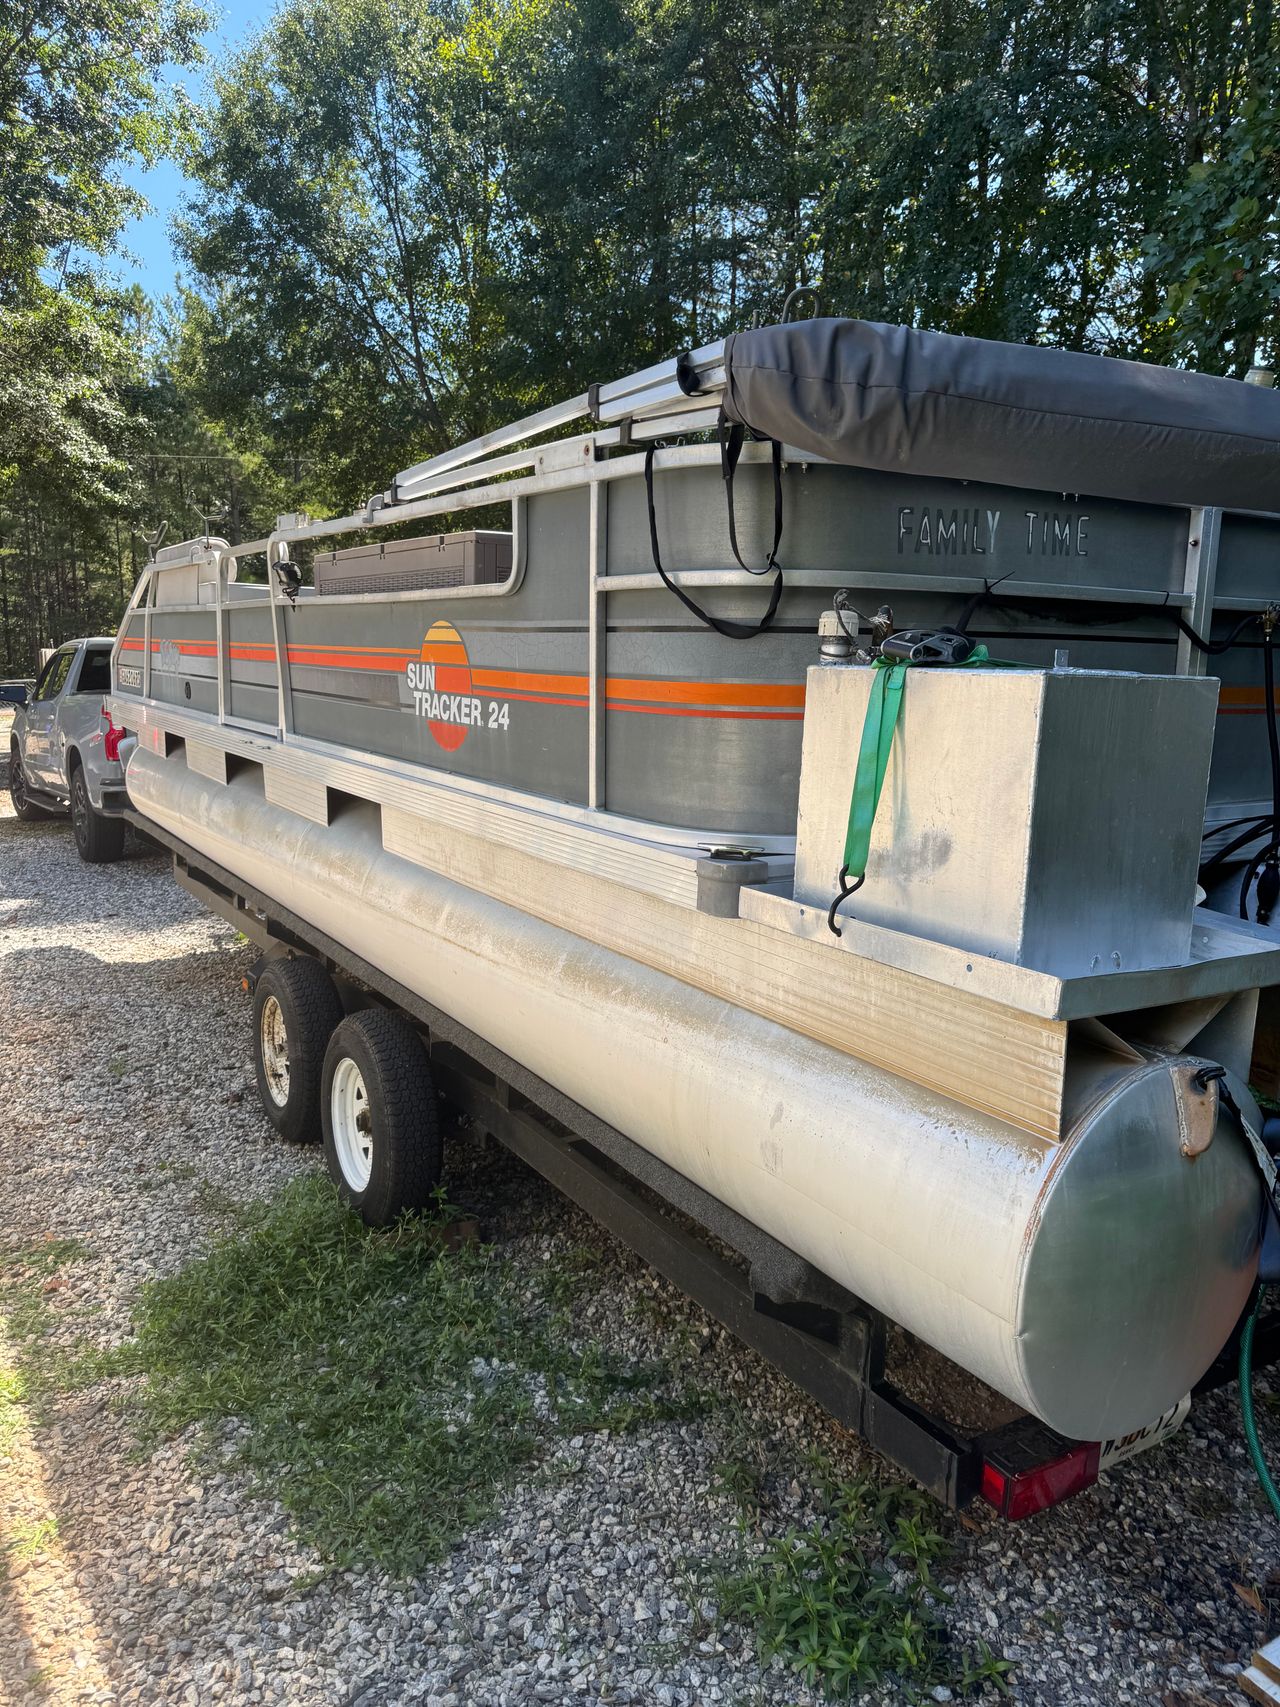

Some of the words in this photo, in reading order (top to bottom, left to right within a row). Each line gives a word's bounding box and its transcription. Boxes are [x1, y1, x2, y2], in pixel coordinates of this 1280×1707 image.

[898, 507, 1001, 555] FAMILY
[1024, 511, 1090, 557] TIME
[407, 662, 436, 691] SUN
[413, 691, 482, 726] TRACKER
[488, 701, 510, 731] 24
